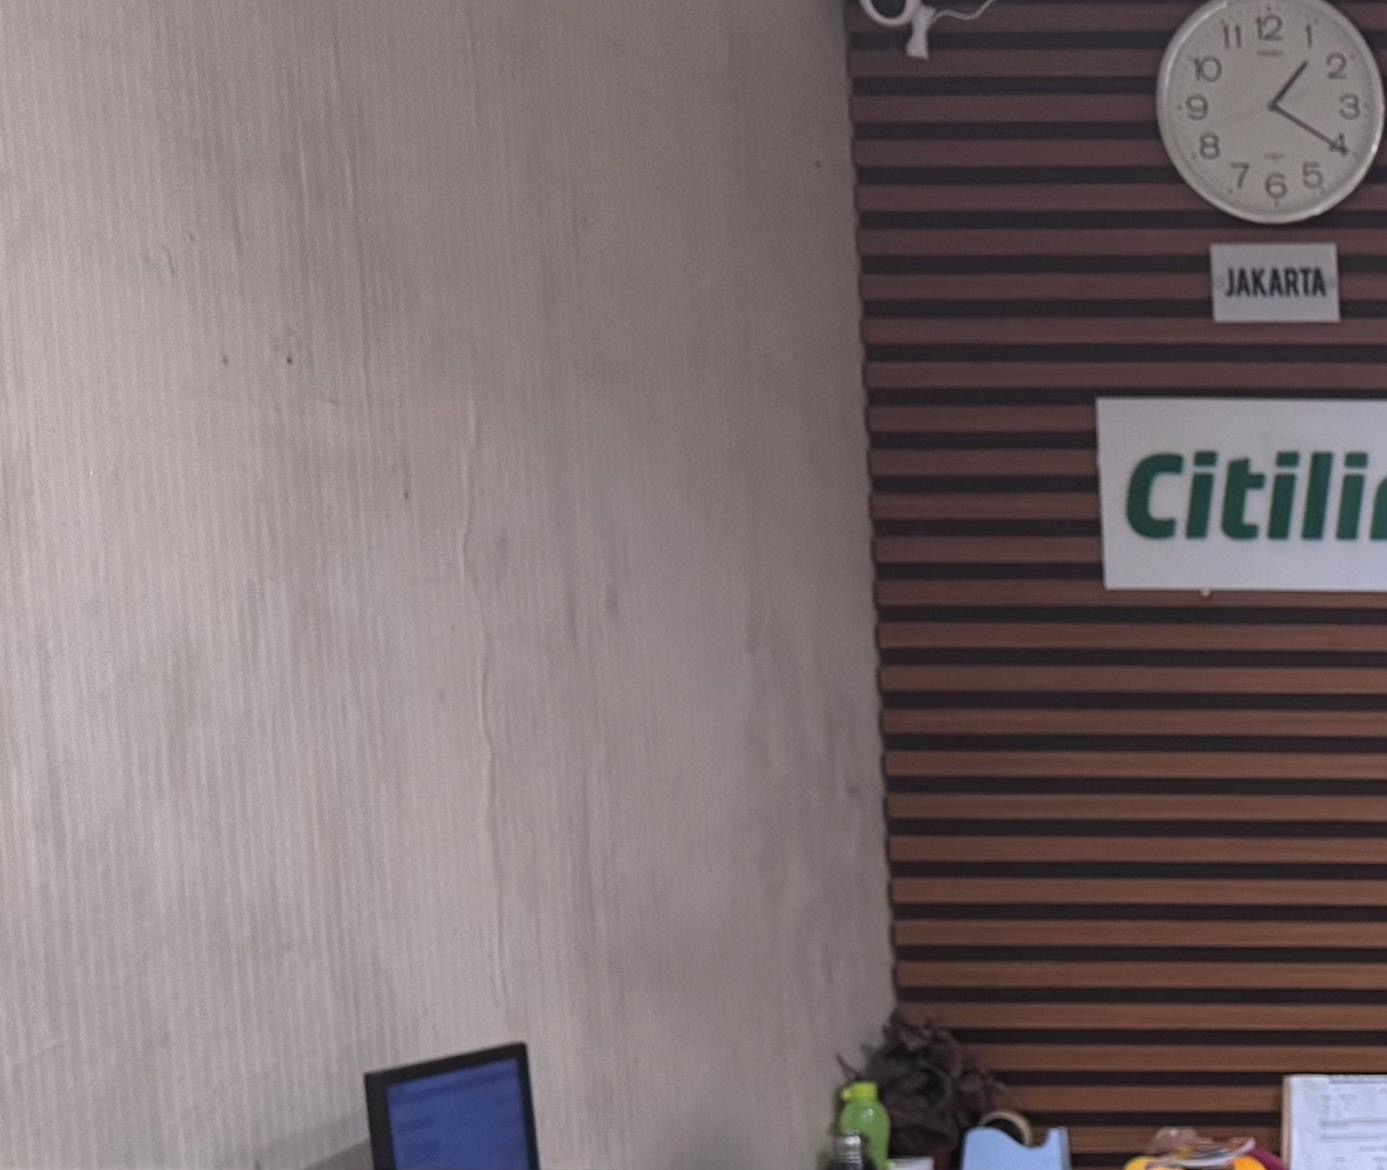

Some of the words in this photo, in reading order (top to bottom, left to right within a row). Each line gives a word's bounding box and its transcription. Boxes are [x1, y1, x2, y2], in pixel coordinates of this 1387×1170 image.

[1221, 23, 1242, 49] 11
[1256, 15, 1283, 41] 12
[1193, 56, 1221, 82] 10
[1327, 53, 1347, 79] 2
[1186, 95, 1208, 120] 9
[1339, 94, 1360, 119] 3
[1199, 133, 1220, 159] 8
[1230, 163, 1250, 189] 7
[1265, 172, 1286, 198] 6
[1303, 162, 1324, 188] 5
[1225, 267, 1326, 297] JAKARTA
